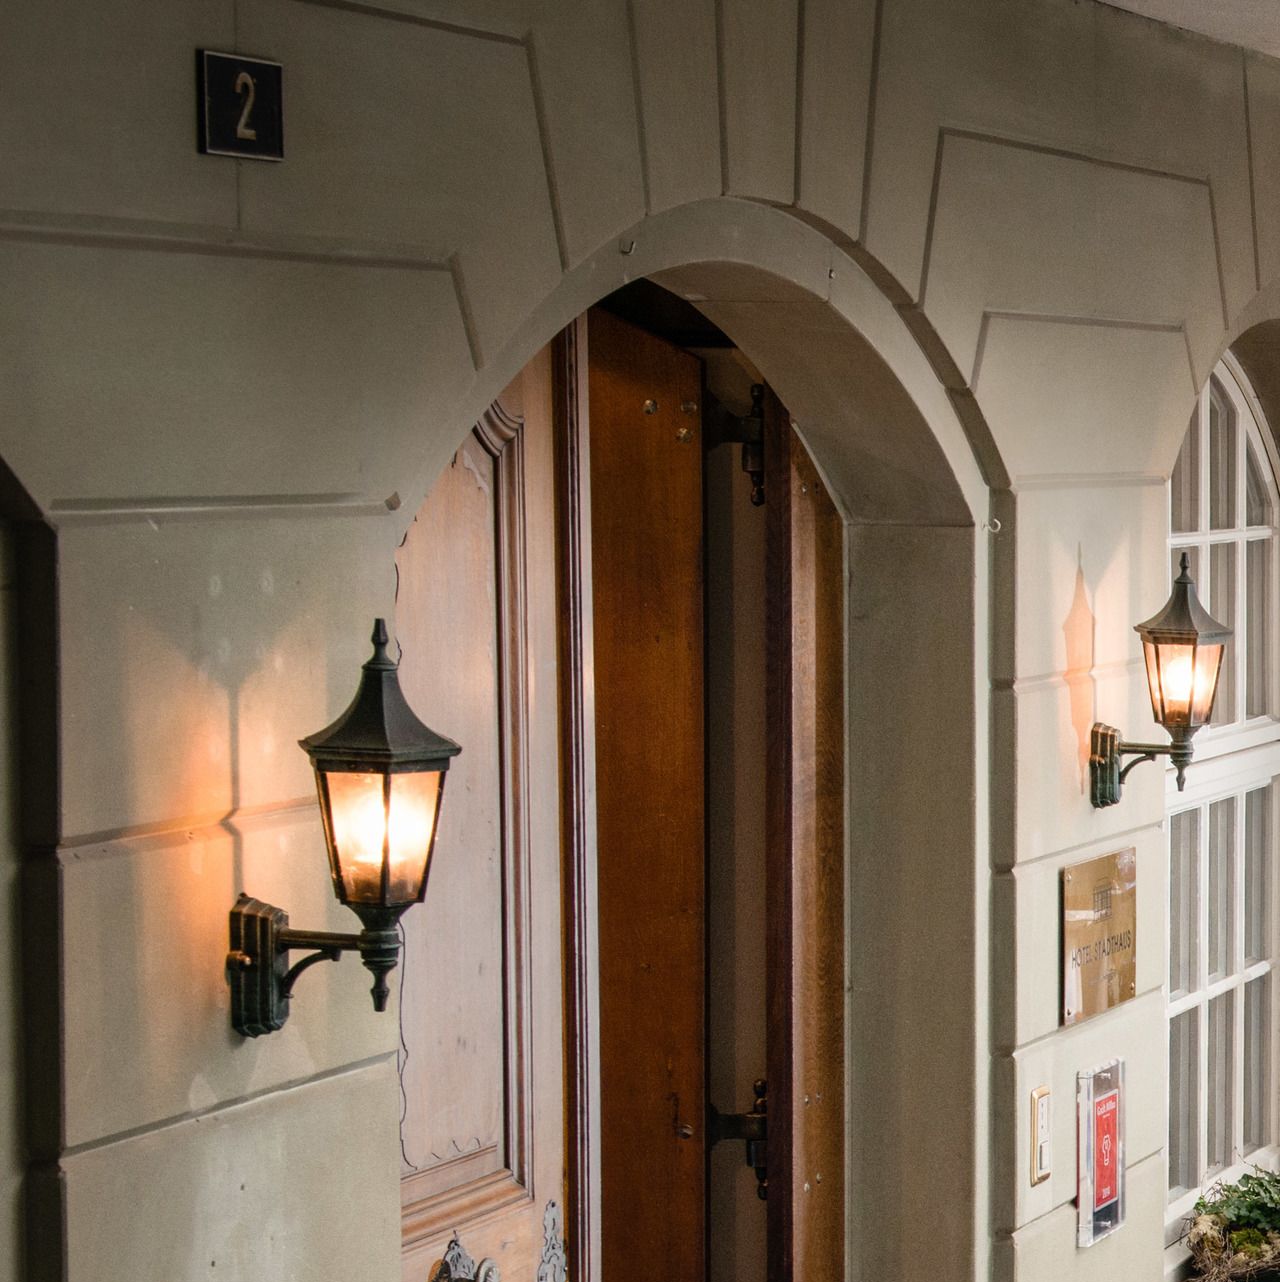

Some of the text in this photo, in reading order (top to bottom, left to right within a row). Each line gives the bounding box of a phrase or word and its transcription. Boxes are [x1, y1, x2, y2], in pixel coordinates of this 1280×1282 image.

[234, 71, 257, 141] 2
[1071, 928, 1131, 969] HOTEL STADTHAUS
